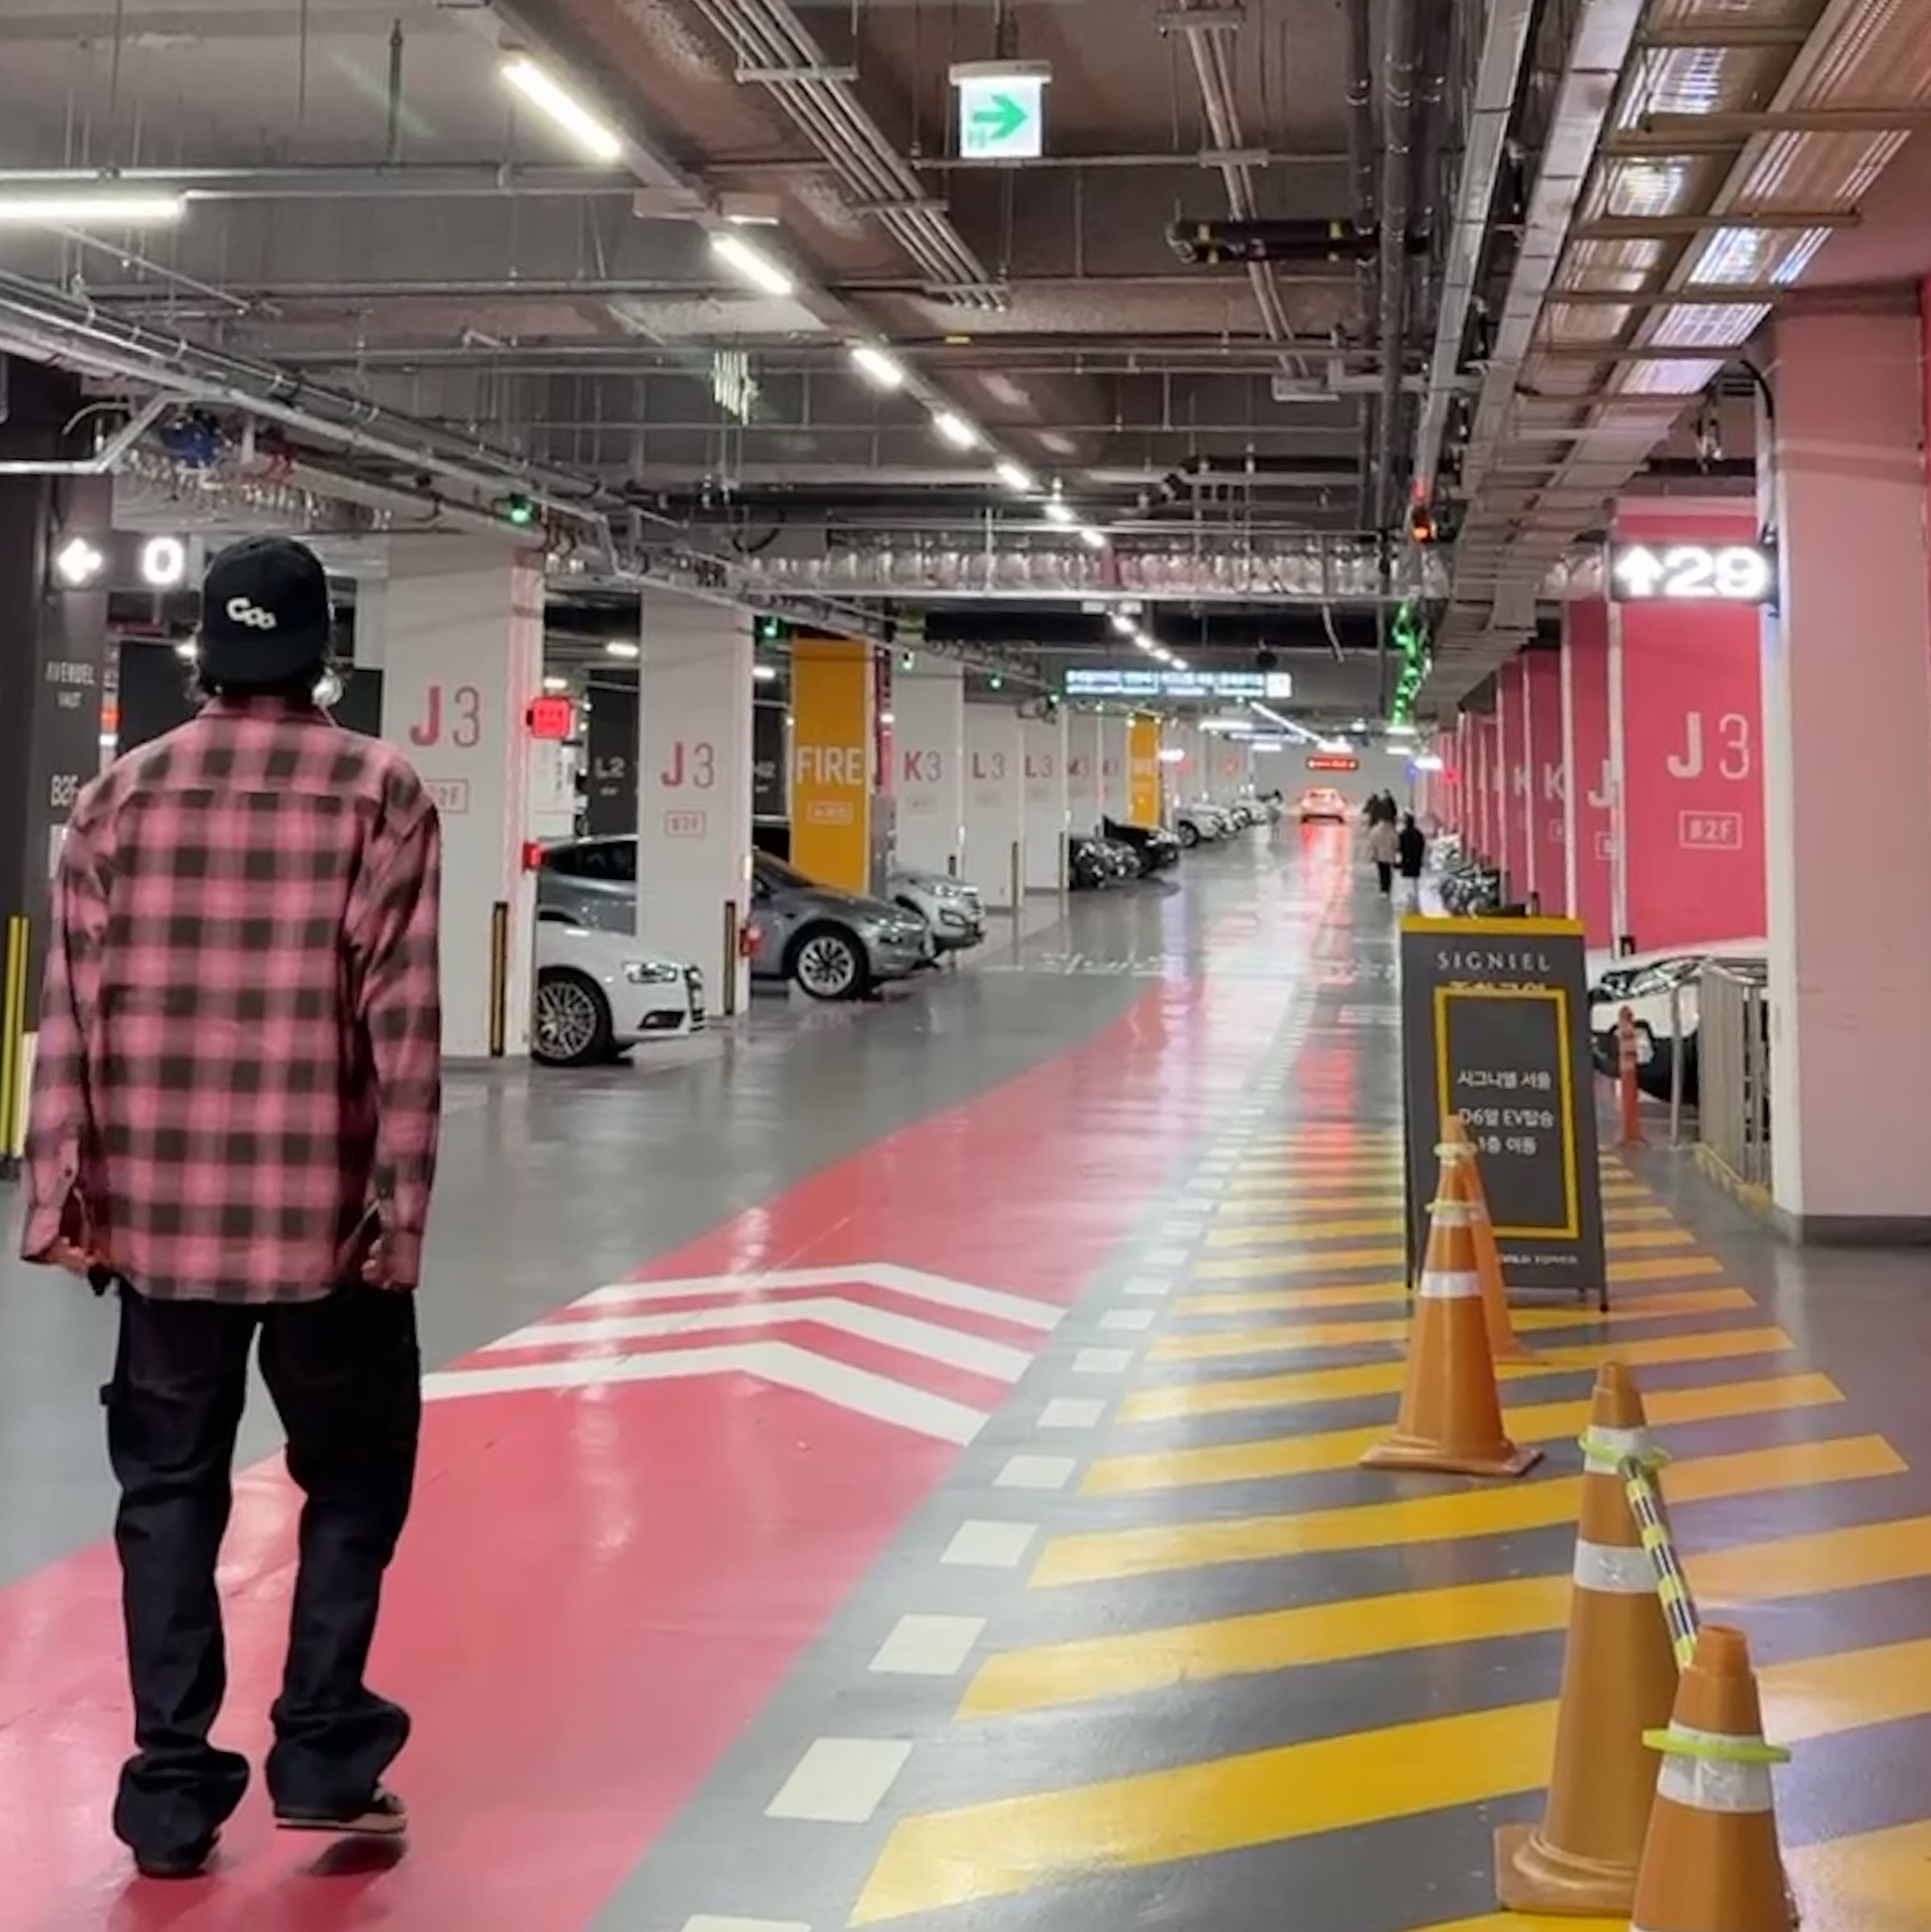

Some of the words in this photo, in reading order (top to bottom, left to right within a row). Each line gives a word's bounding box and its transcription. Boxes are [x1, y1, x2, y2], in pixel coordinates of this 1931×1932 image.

[1664, 545, 1770, 597] 29
[409, 685, 479, 748] J3
[661, 741, 714, 789] J3
[797, 745, 863, 786] FIRE
[904, 750, 941, 782] K3
[972, 752, 1005, 779] L3
[1667, 711, 1750, 781] J3
[1437, 951, 1551, 972] SIGNIEL
